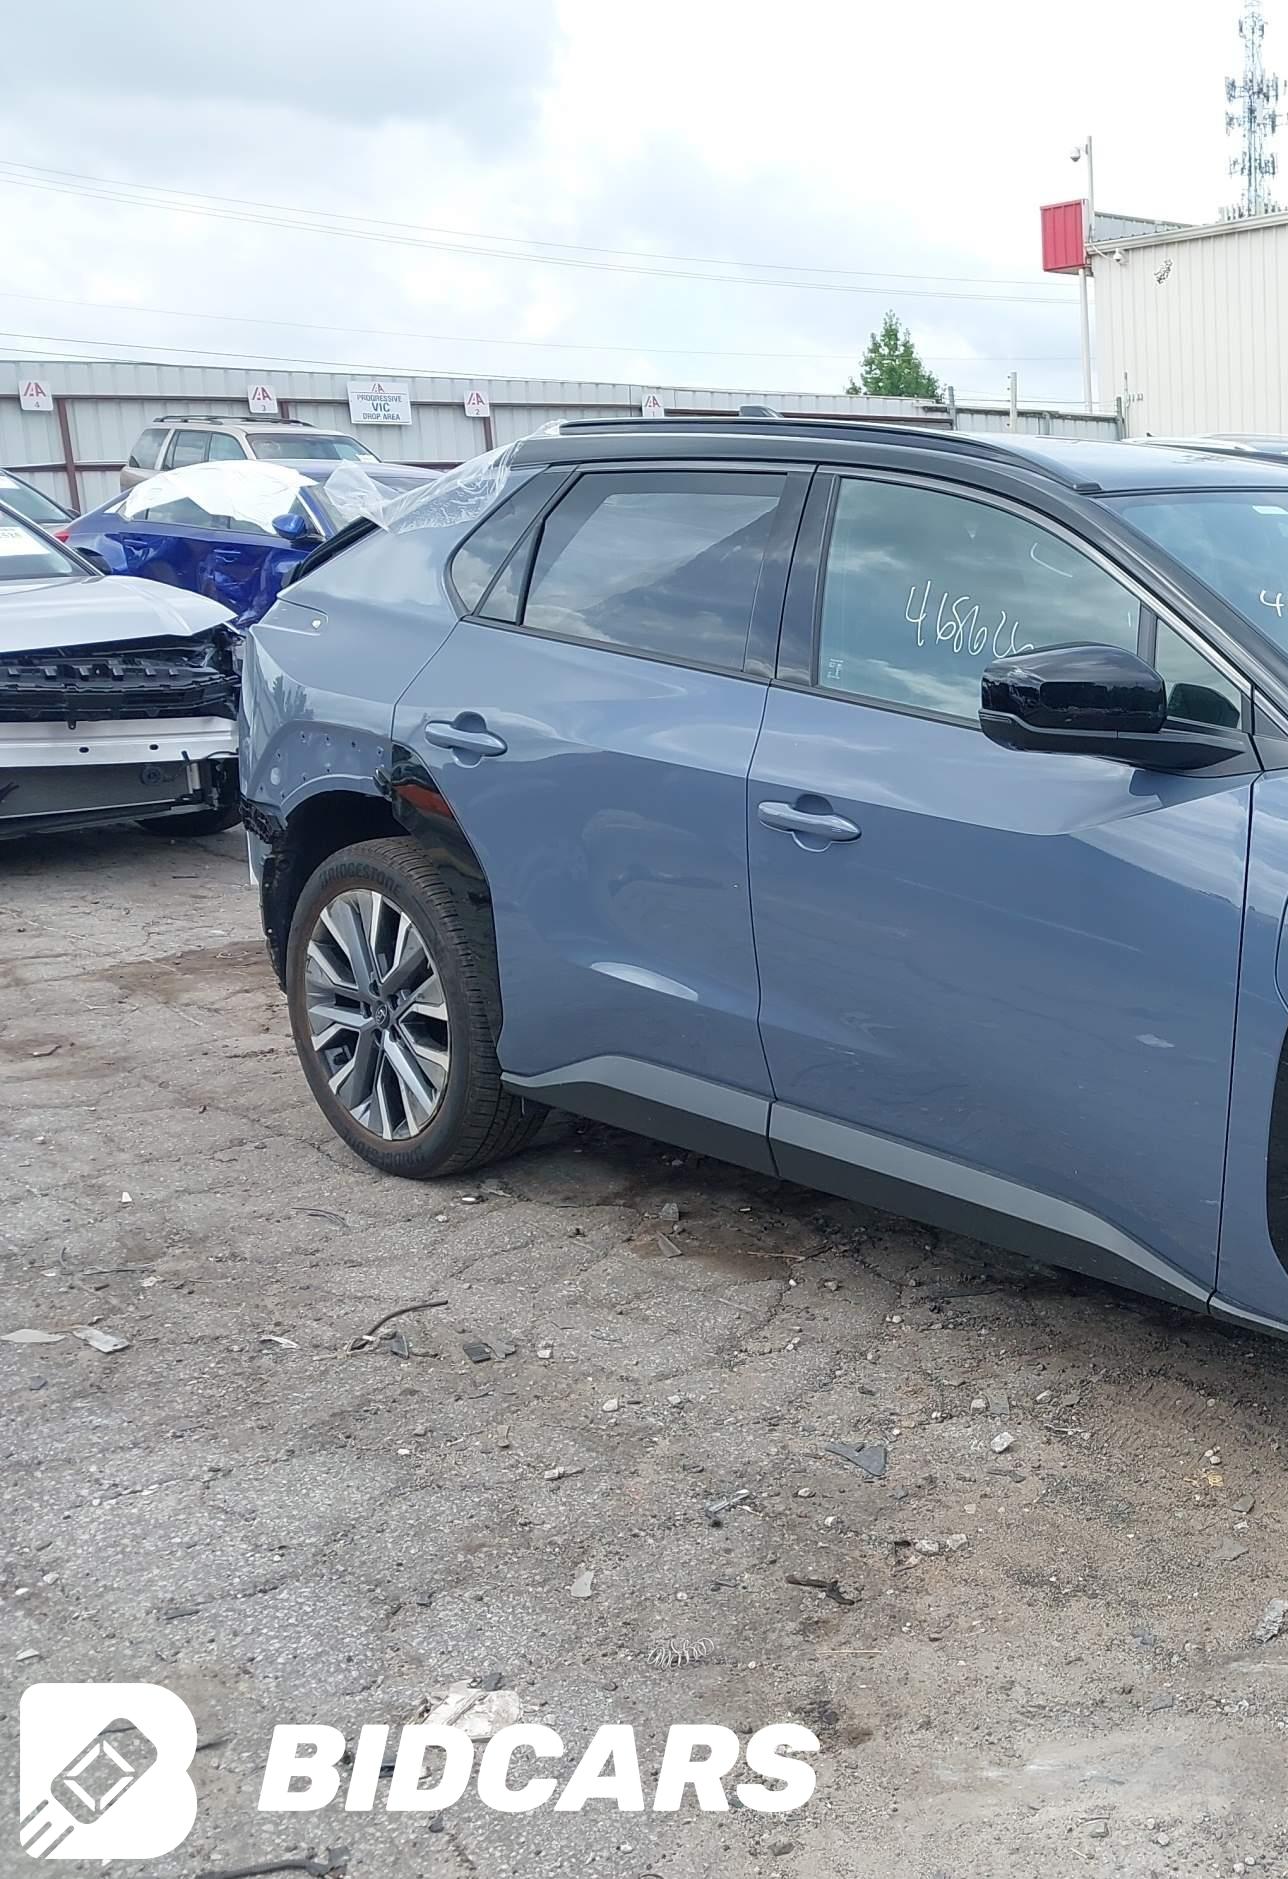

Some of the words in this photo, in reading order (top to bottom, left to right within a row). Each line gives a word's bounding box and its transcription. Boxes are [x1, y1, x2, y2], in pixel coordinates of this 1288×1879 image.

[356, 394, 402, 402] PROGRESSIVE
[371, 402, 391, 412] VIC
[362, 412, 381, 420] DROP
[383, 413, 401, 421] AREA
[320, 862, 402, 897] BRIDGESTONE
